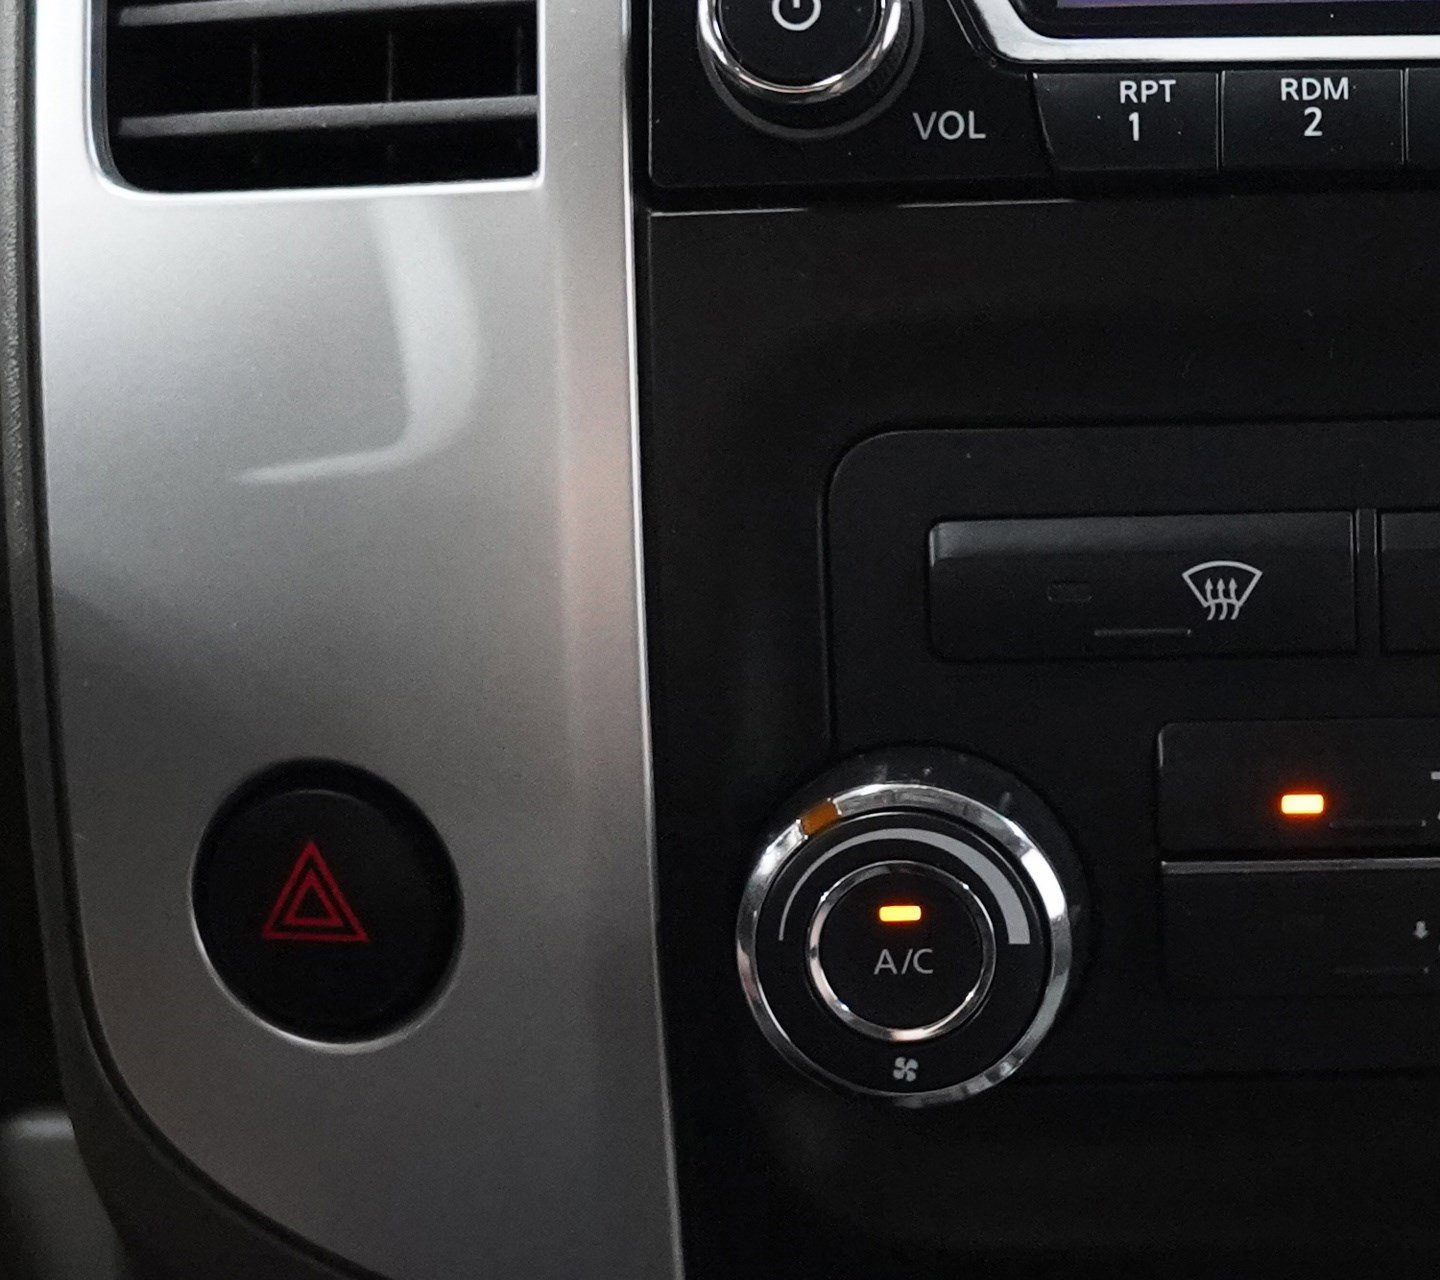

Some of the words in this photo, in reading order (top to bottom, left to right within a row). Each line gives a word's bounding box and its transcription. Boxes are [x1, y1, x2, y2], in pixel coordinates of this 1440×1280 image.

[1119, 79, 1177, 104] RPT
[1280, 76, 1349, 101] RDM
[912, 110, 987, 140] VOL
[1128, 111, 1140, 142] 1
[1303, 106, 1323, 137] 2
[873, 948, 934, 975] A/C
